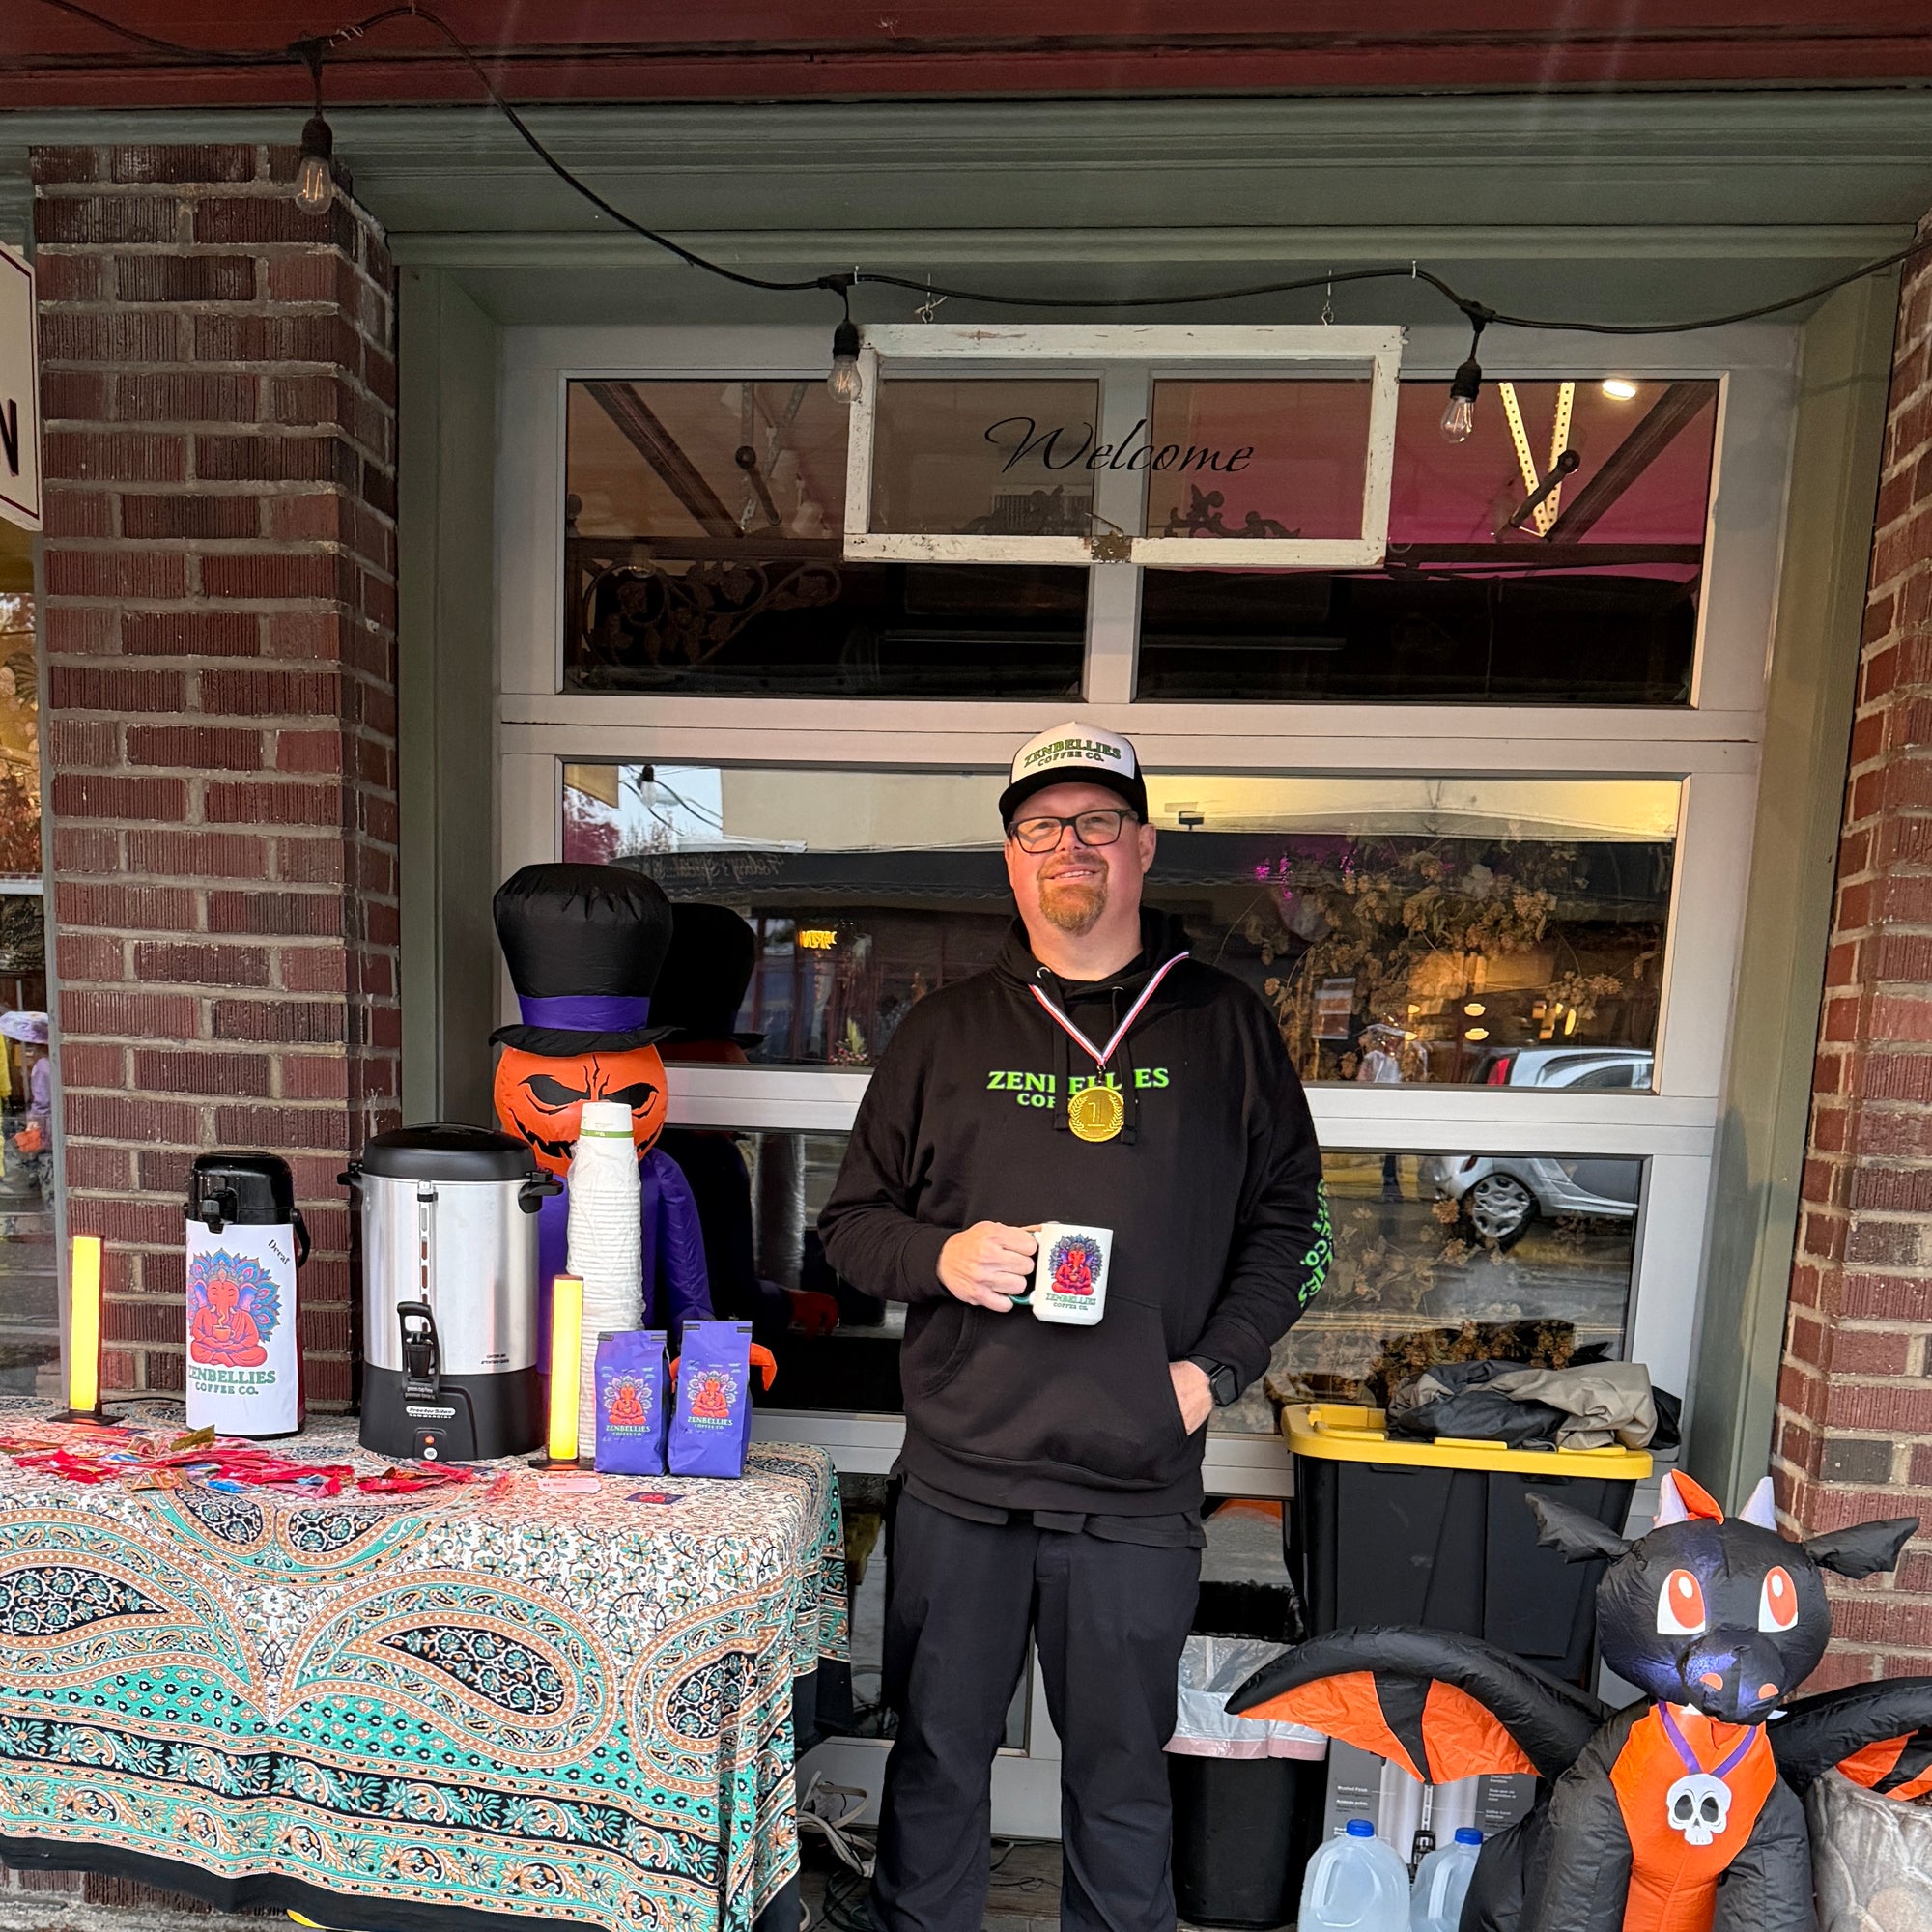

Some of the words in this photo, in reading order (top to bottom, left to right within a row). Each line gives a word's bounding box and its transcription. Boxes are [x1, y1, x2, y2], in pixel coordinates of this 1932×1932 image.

[984, 416, 1254, 473] Welcome
[1023, 738, 1122, 769] ZENBELLIES
[1037, 751, 1082, 767] COFFEE
[986, 1068, 1170, 1095] ZENELES
[1045, 1293, 1096, 1306] ZENBELLIES
[195, 1381, 235, 1394] COFFEE
[238, 1385, 259, 1395] CO.
[605, 1424, 651, 1433] ZENBELLIES
[687, 1415, 734, 1427] ZENBELLIES
